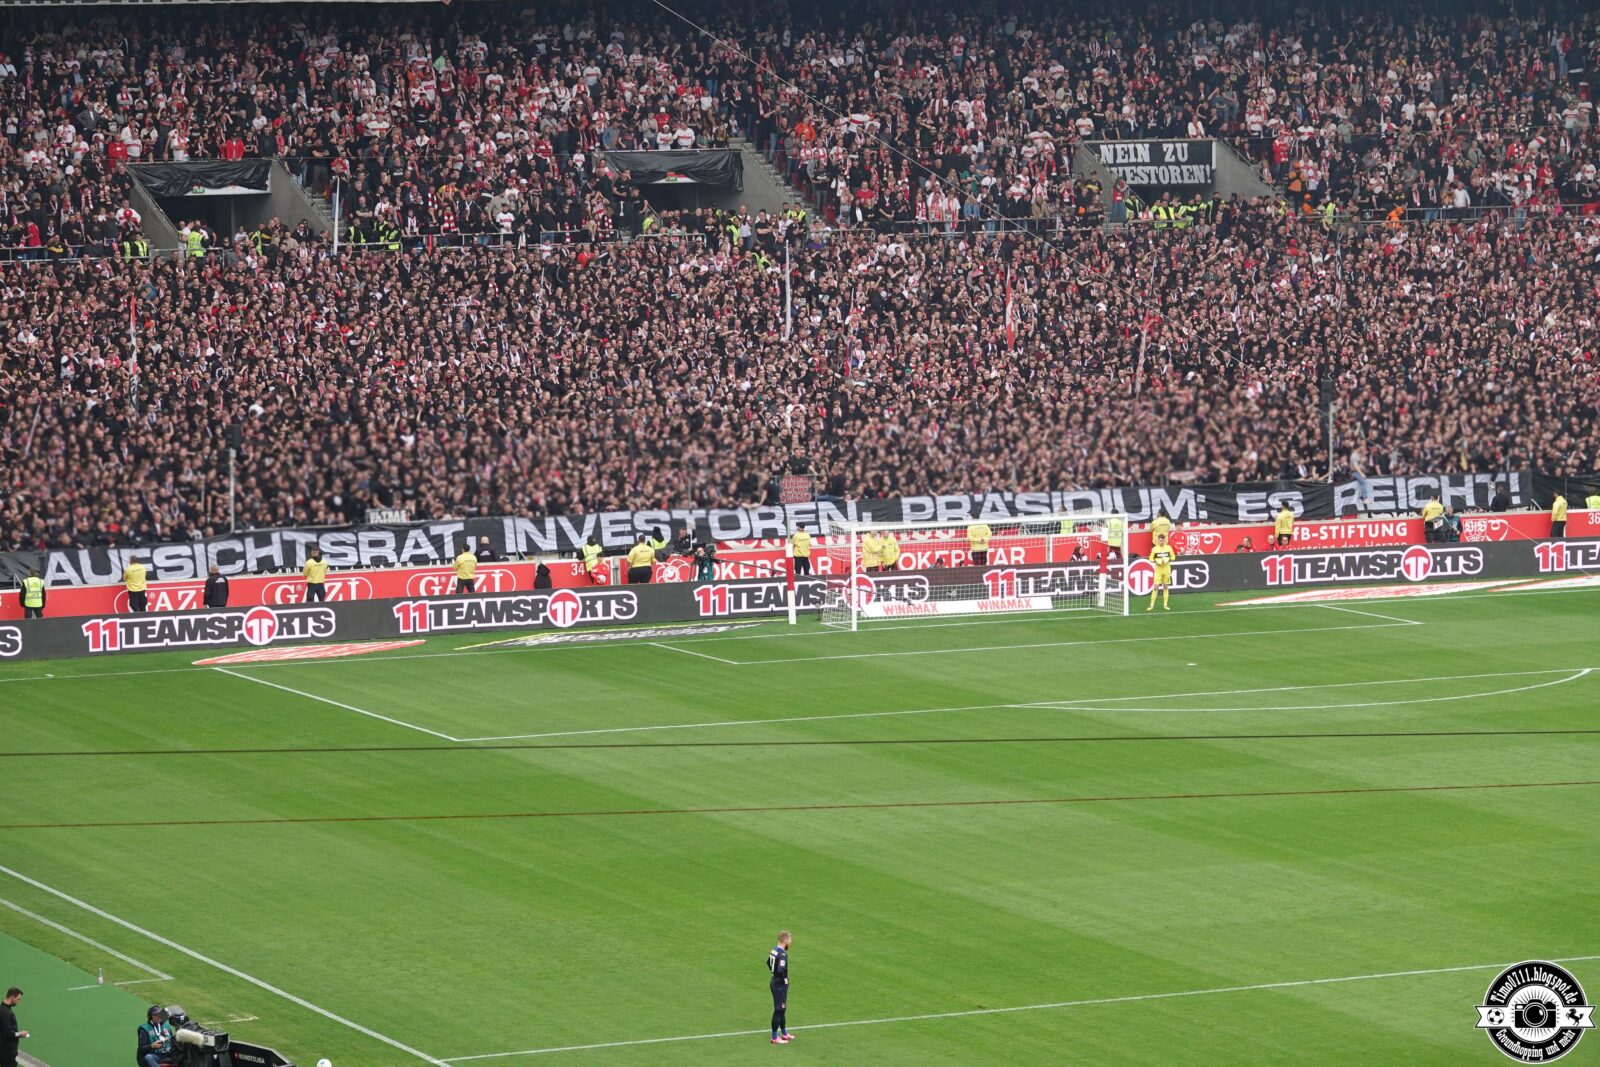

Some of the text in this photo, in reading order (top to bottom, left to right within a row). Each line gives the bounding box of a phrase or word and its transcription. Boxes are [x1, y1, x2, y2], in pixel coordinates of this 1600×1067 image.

[1100, 142, 1188, 164] NEIN ZU
[1109, 164, 1212, 185] VESTOREN!
[1236, 491, 1304, 521] ES
[1334, 472, 1521, 516] REICHT!
[1293, 522, 1408, 541] fB-STIFTUNG
[1534, 541, 1600, 572] 11TE
[571, 563, 585, 576] 34
[882, 602, 939, 615] WINAMAX
[977, 599, 1032, 611] WINAMAX
